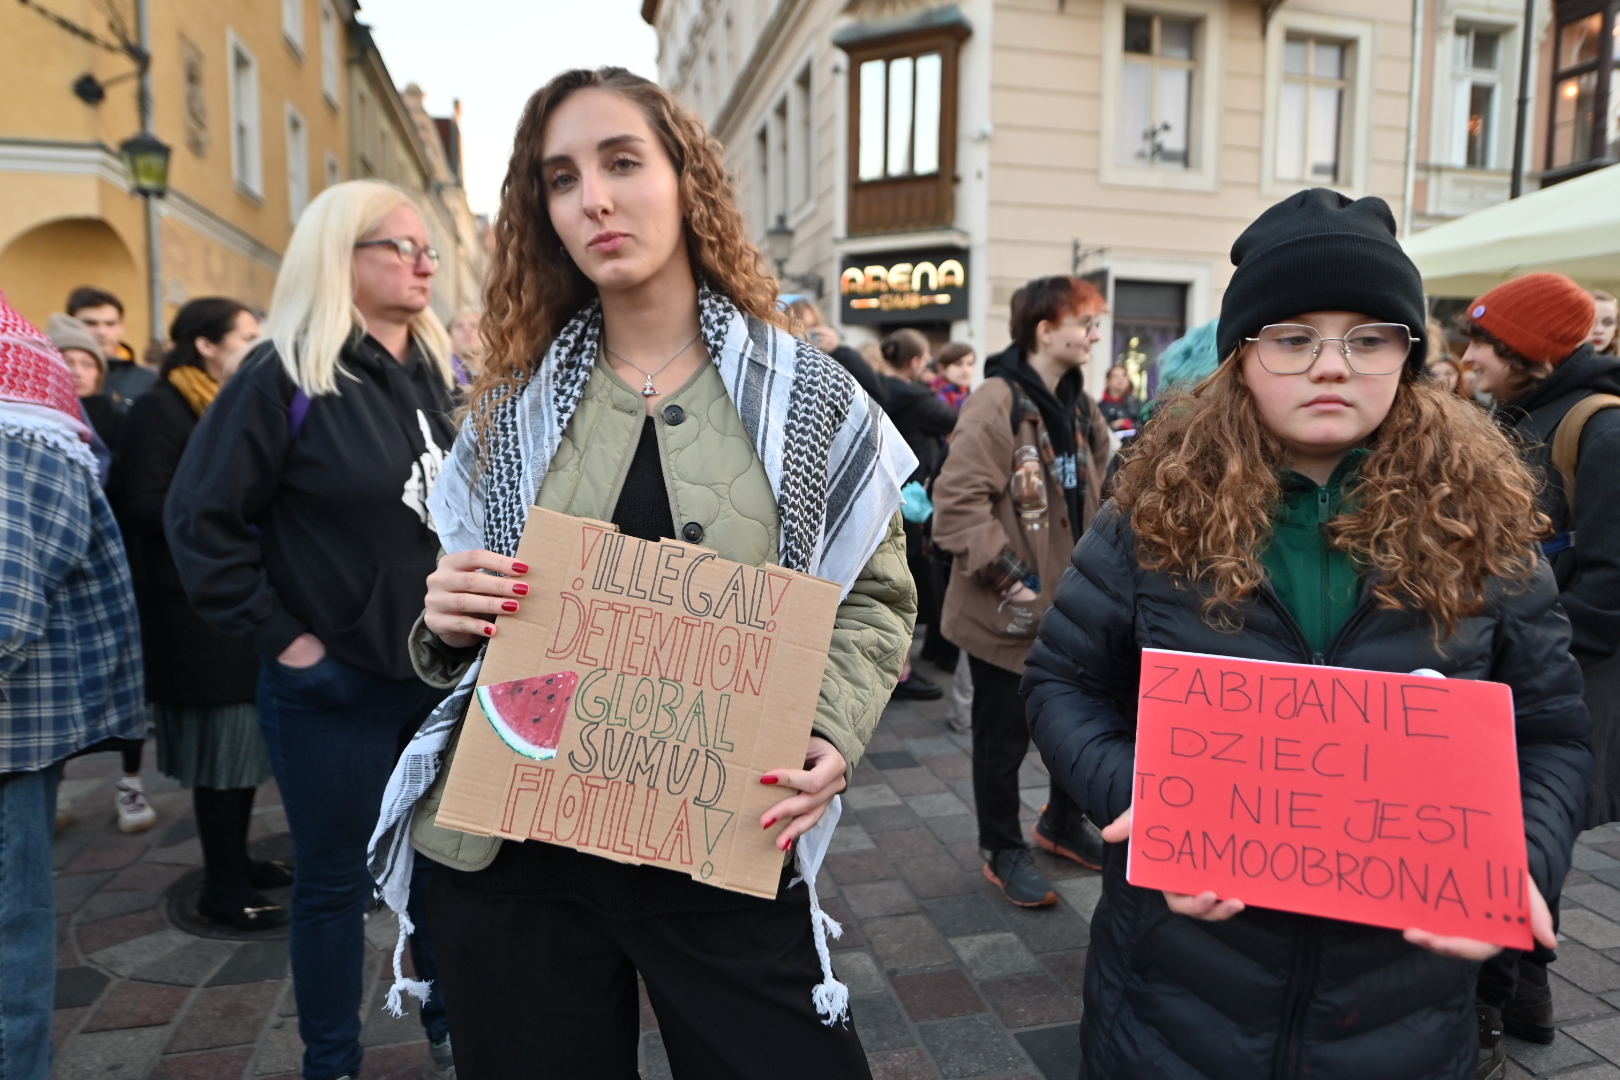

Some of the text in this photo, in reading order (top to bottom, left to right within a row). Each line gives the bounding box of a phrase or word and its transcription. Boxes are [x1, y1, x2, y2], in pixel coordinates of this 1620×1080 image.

[840, 259, 965, 296] ARENA
[545, 591, 772, 696] DETENTION
[574, 668, 734, 752] GLOBAL
[1141, 665, 1450, 739] ZABIJANIE
[568, 722, 726, 807] SUMUD
[1170, 726, 1370, 782] DZIECI
[1135, 771, 1492, 849] TO NIE JEST
